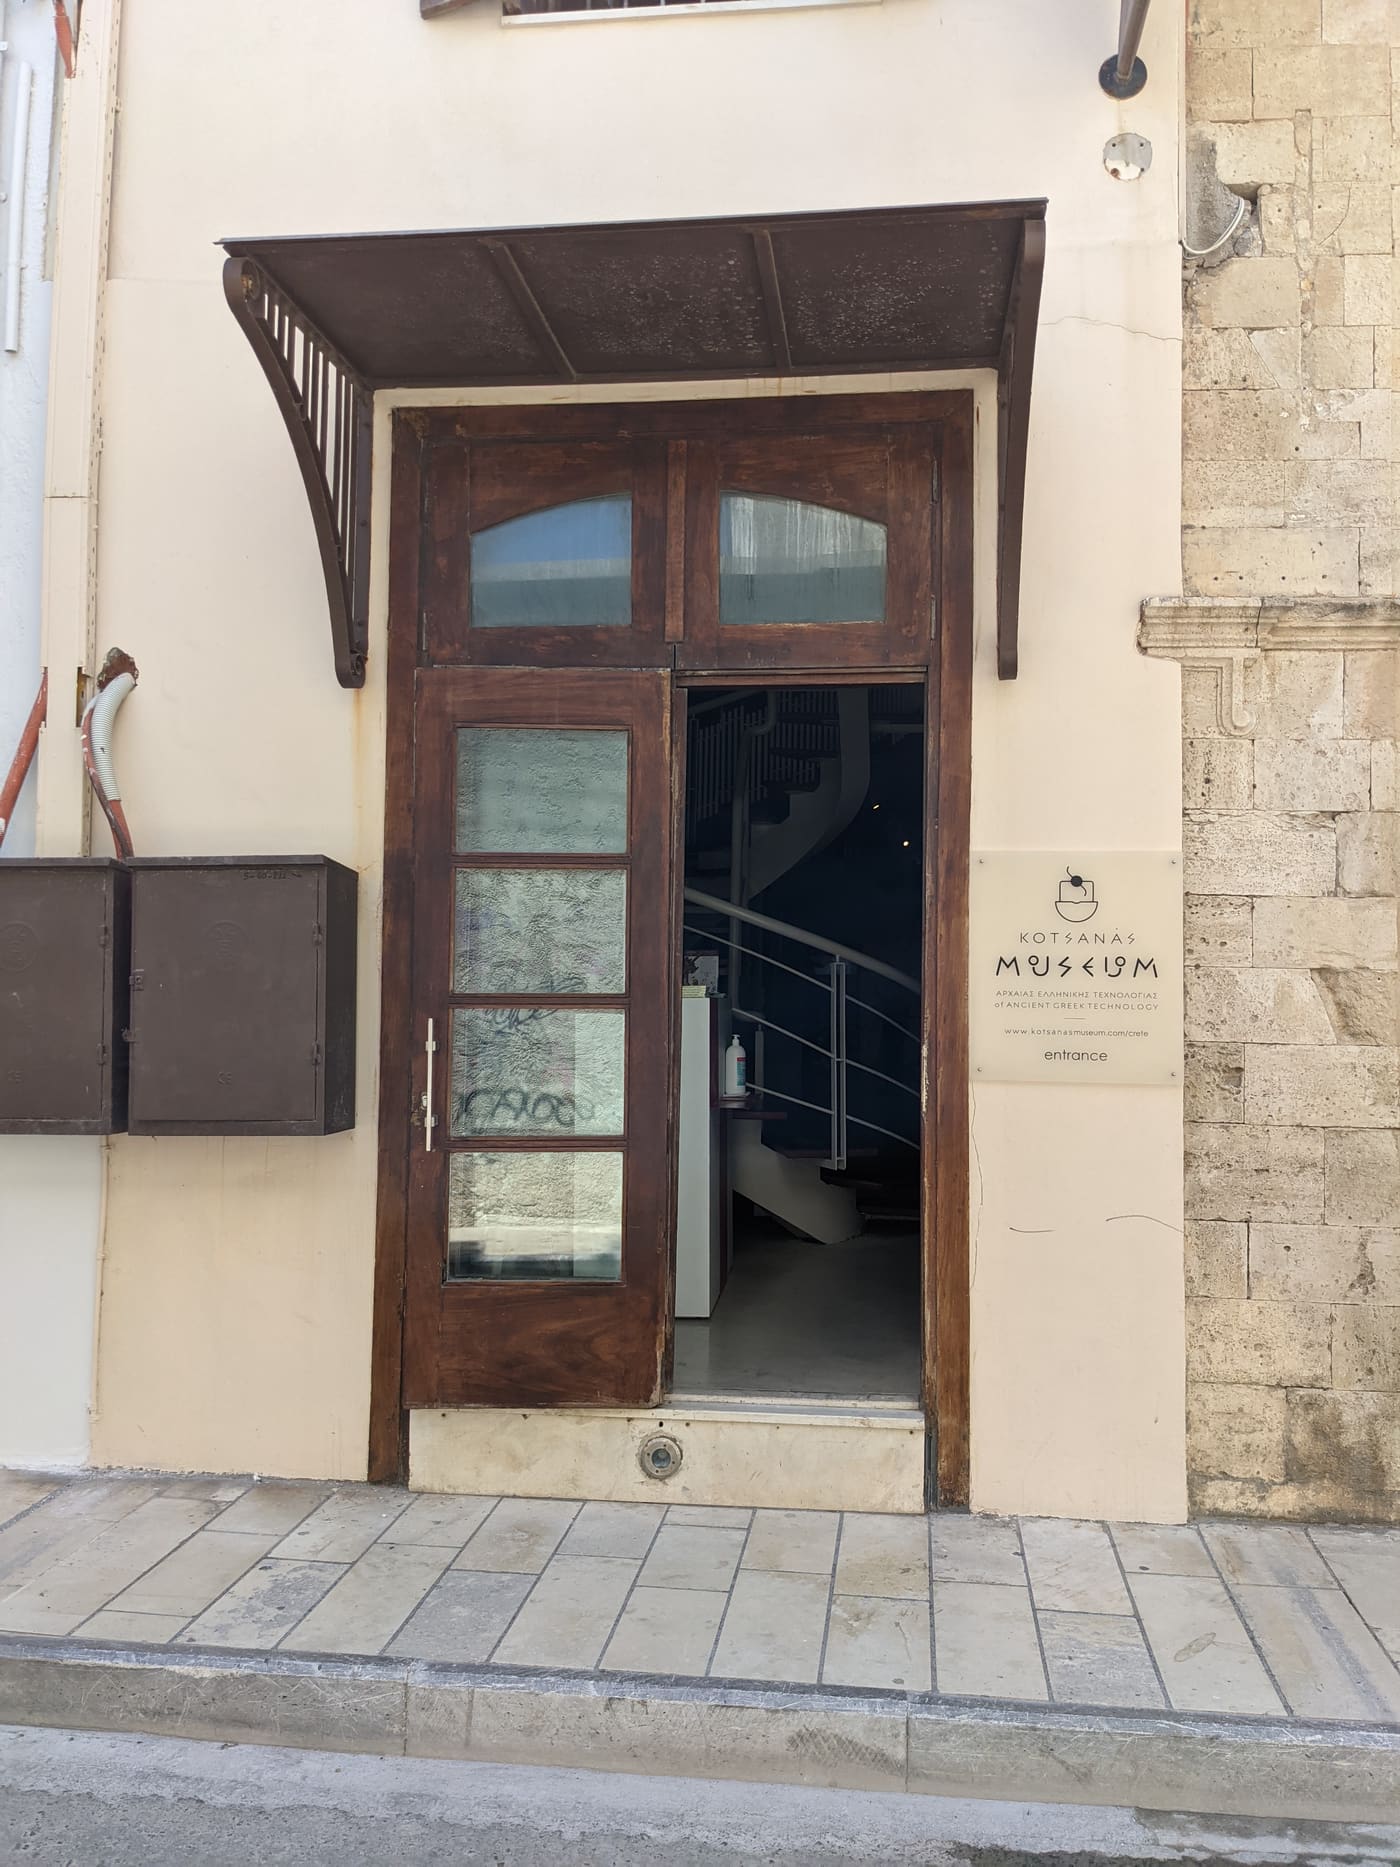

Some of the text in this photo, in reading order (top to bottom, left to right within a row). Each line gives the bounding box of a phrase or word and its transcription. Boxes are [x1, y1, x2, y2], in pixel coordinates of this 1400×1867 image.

[996, 990, 1159, 1000] ΑΡΧΑΙΑΣ ΕΛΛΗΝΙΚΗΣ ΤΕΧΝΟΛΟΓΙΑΣ
[1006, 1001, 1050, 1009] ANCIENT
[1053, 1002, 1085, 1010] GREEK
[1088, 1002, 1159, 1011] TECHNOLOGY
[1044, 1049, 1108, 1062] entrance
